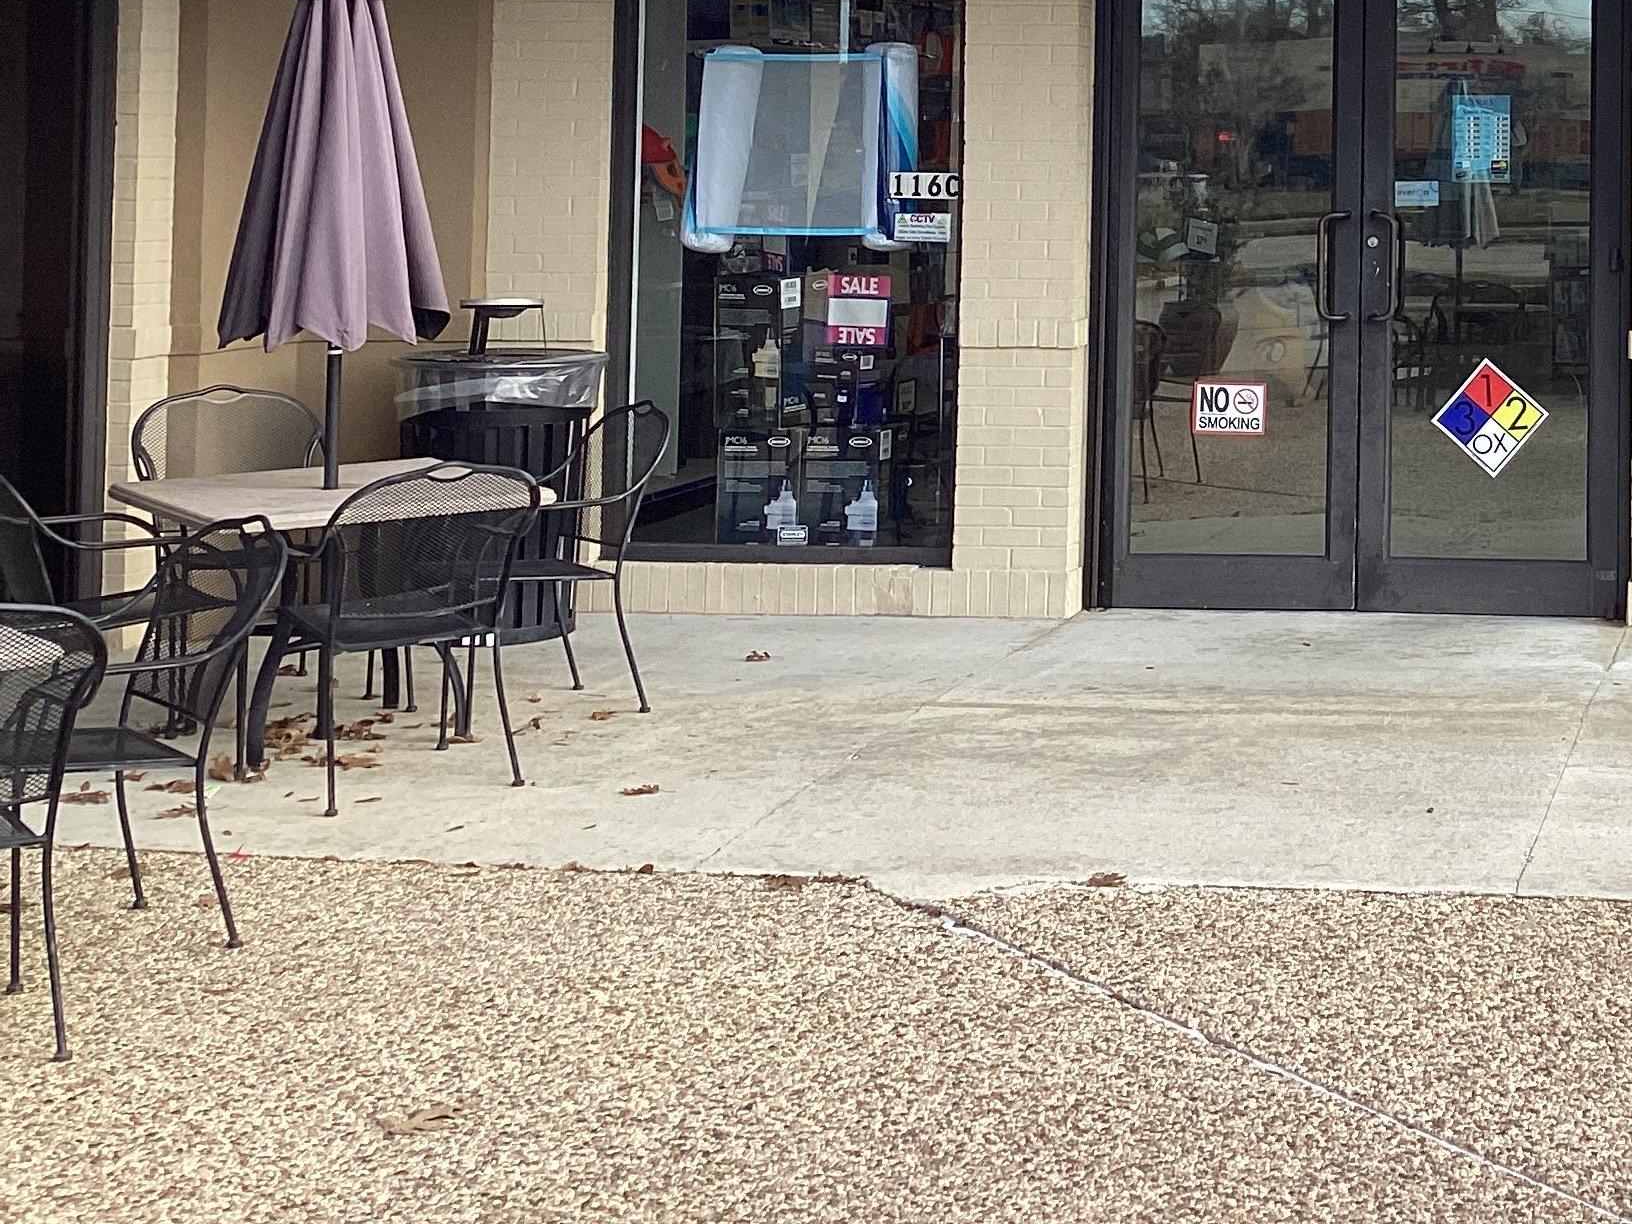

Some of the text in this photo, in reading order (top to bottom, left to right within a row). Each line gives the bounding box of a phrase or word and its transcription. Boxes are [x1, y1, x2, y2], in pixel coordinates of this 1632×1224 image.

[909, 214, 936, 223] CCTV
[840, 276, 879, 294] SALE
[838, 327, 876, 345] SALE
[1200, 386, 1230, 413] NO
[1480, 374, 1492, 407] 1
[1198, 416, 1260, 430] SMOKING
[1455, 396, 1529, 435] 3 2
[1472, 432, 1508, 455] OX
